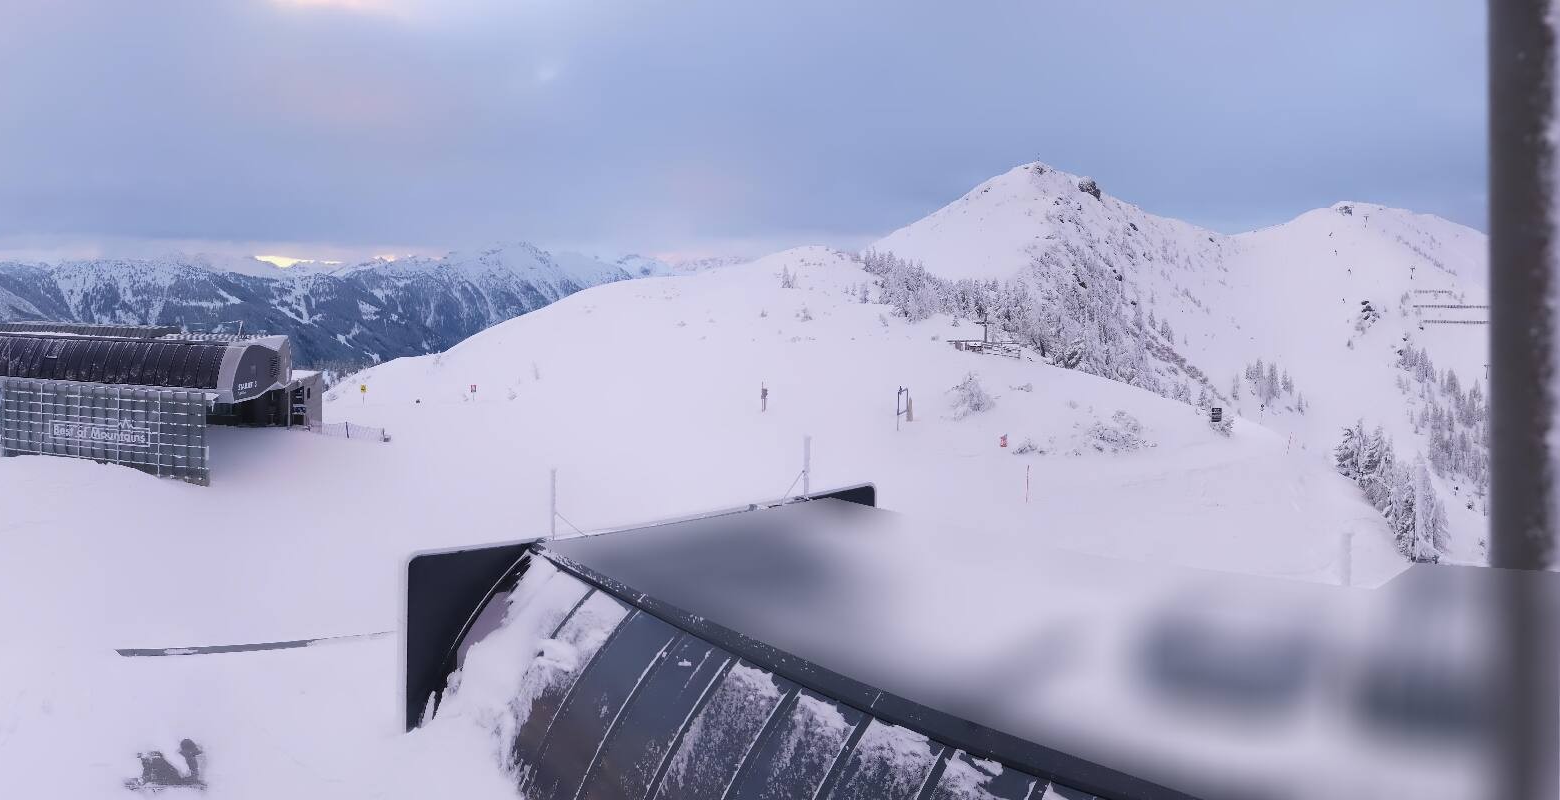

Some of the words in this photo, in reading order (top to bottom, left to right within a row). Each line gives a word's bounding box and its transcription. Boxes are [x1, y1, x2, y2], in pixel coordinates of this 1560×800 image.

[53, 424, 74, 437] Best
[76, 427, 88, 439] of
[90, 427, 146, 443] Mountains
